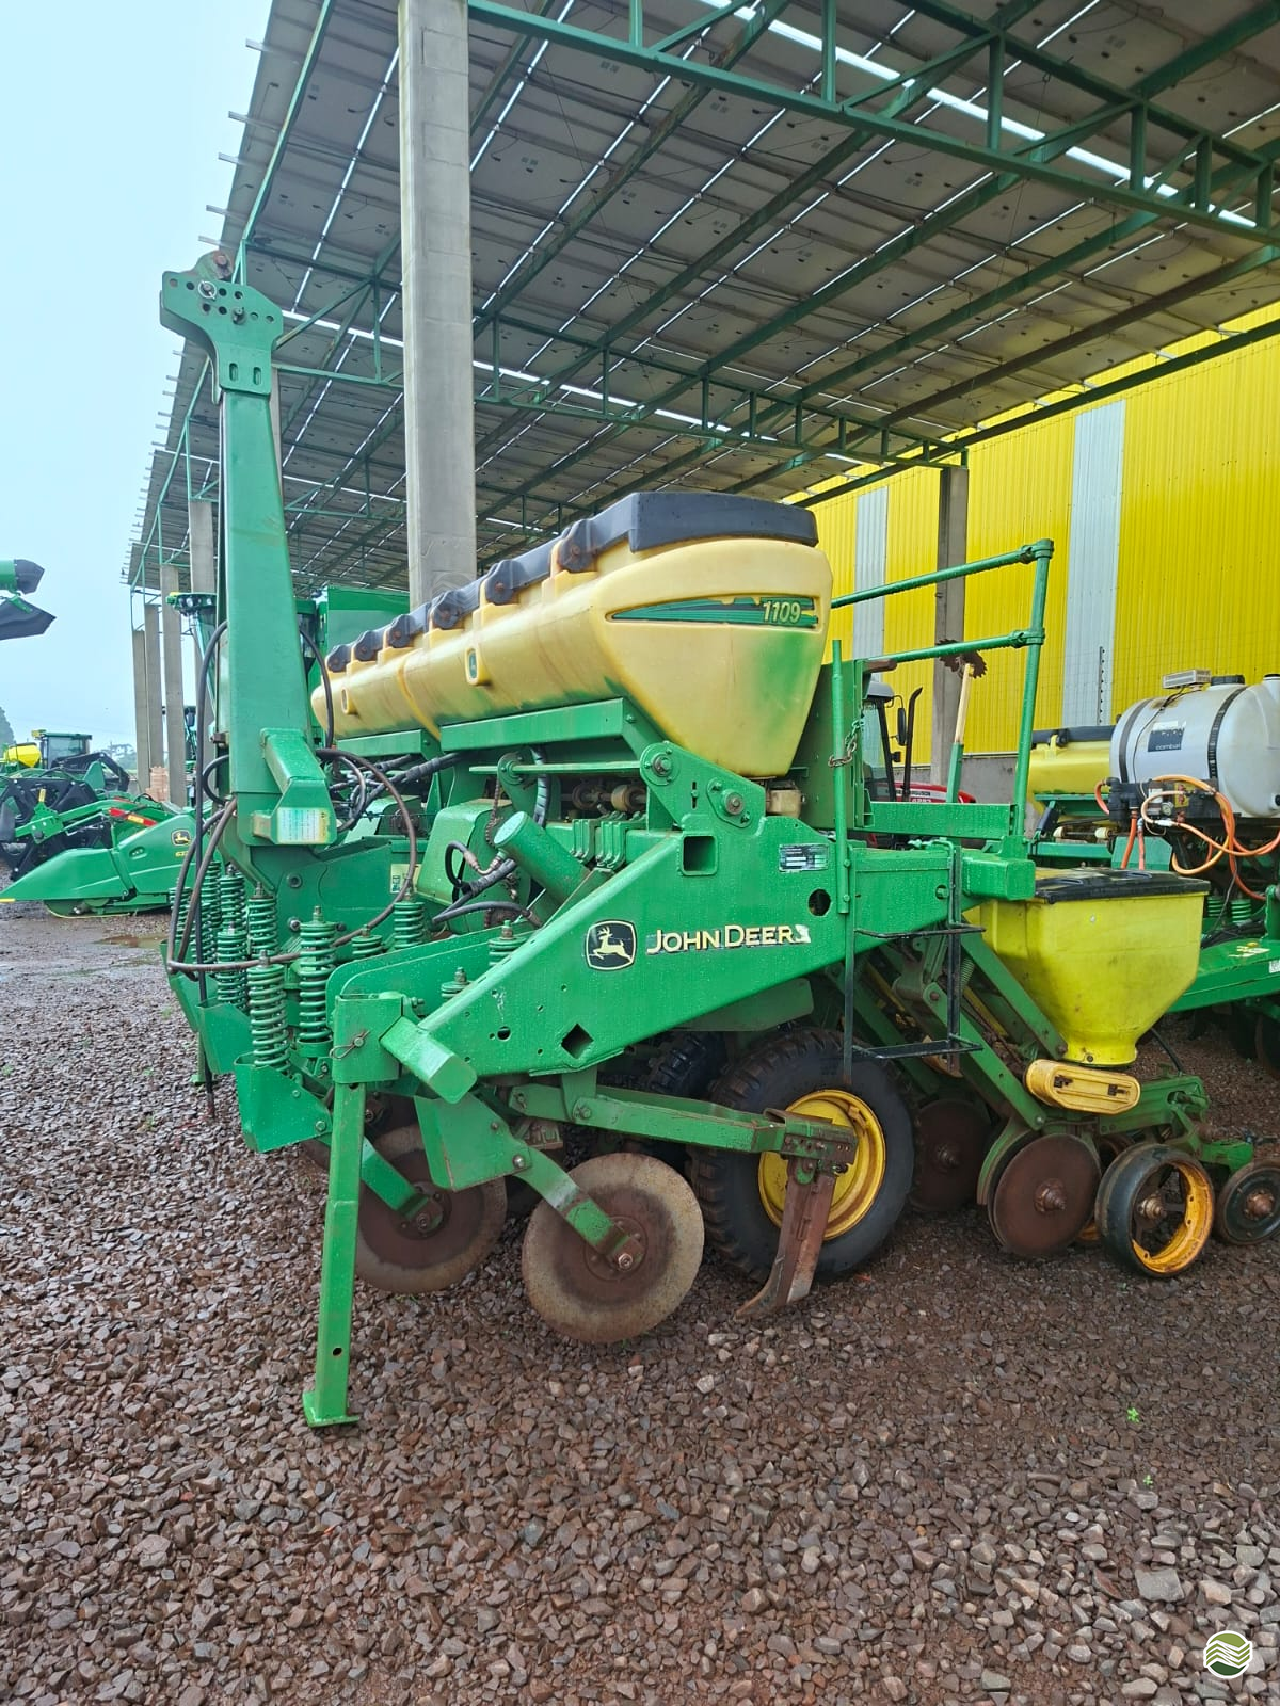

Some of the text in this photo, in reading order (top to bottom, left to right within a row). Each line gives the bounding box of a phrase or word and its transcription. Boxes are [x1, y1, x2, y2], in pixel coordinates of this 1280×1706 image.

[763, 600, 801, 624] 1109
[646, 924, 812, 955] JOHN DEER
